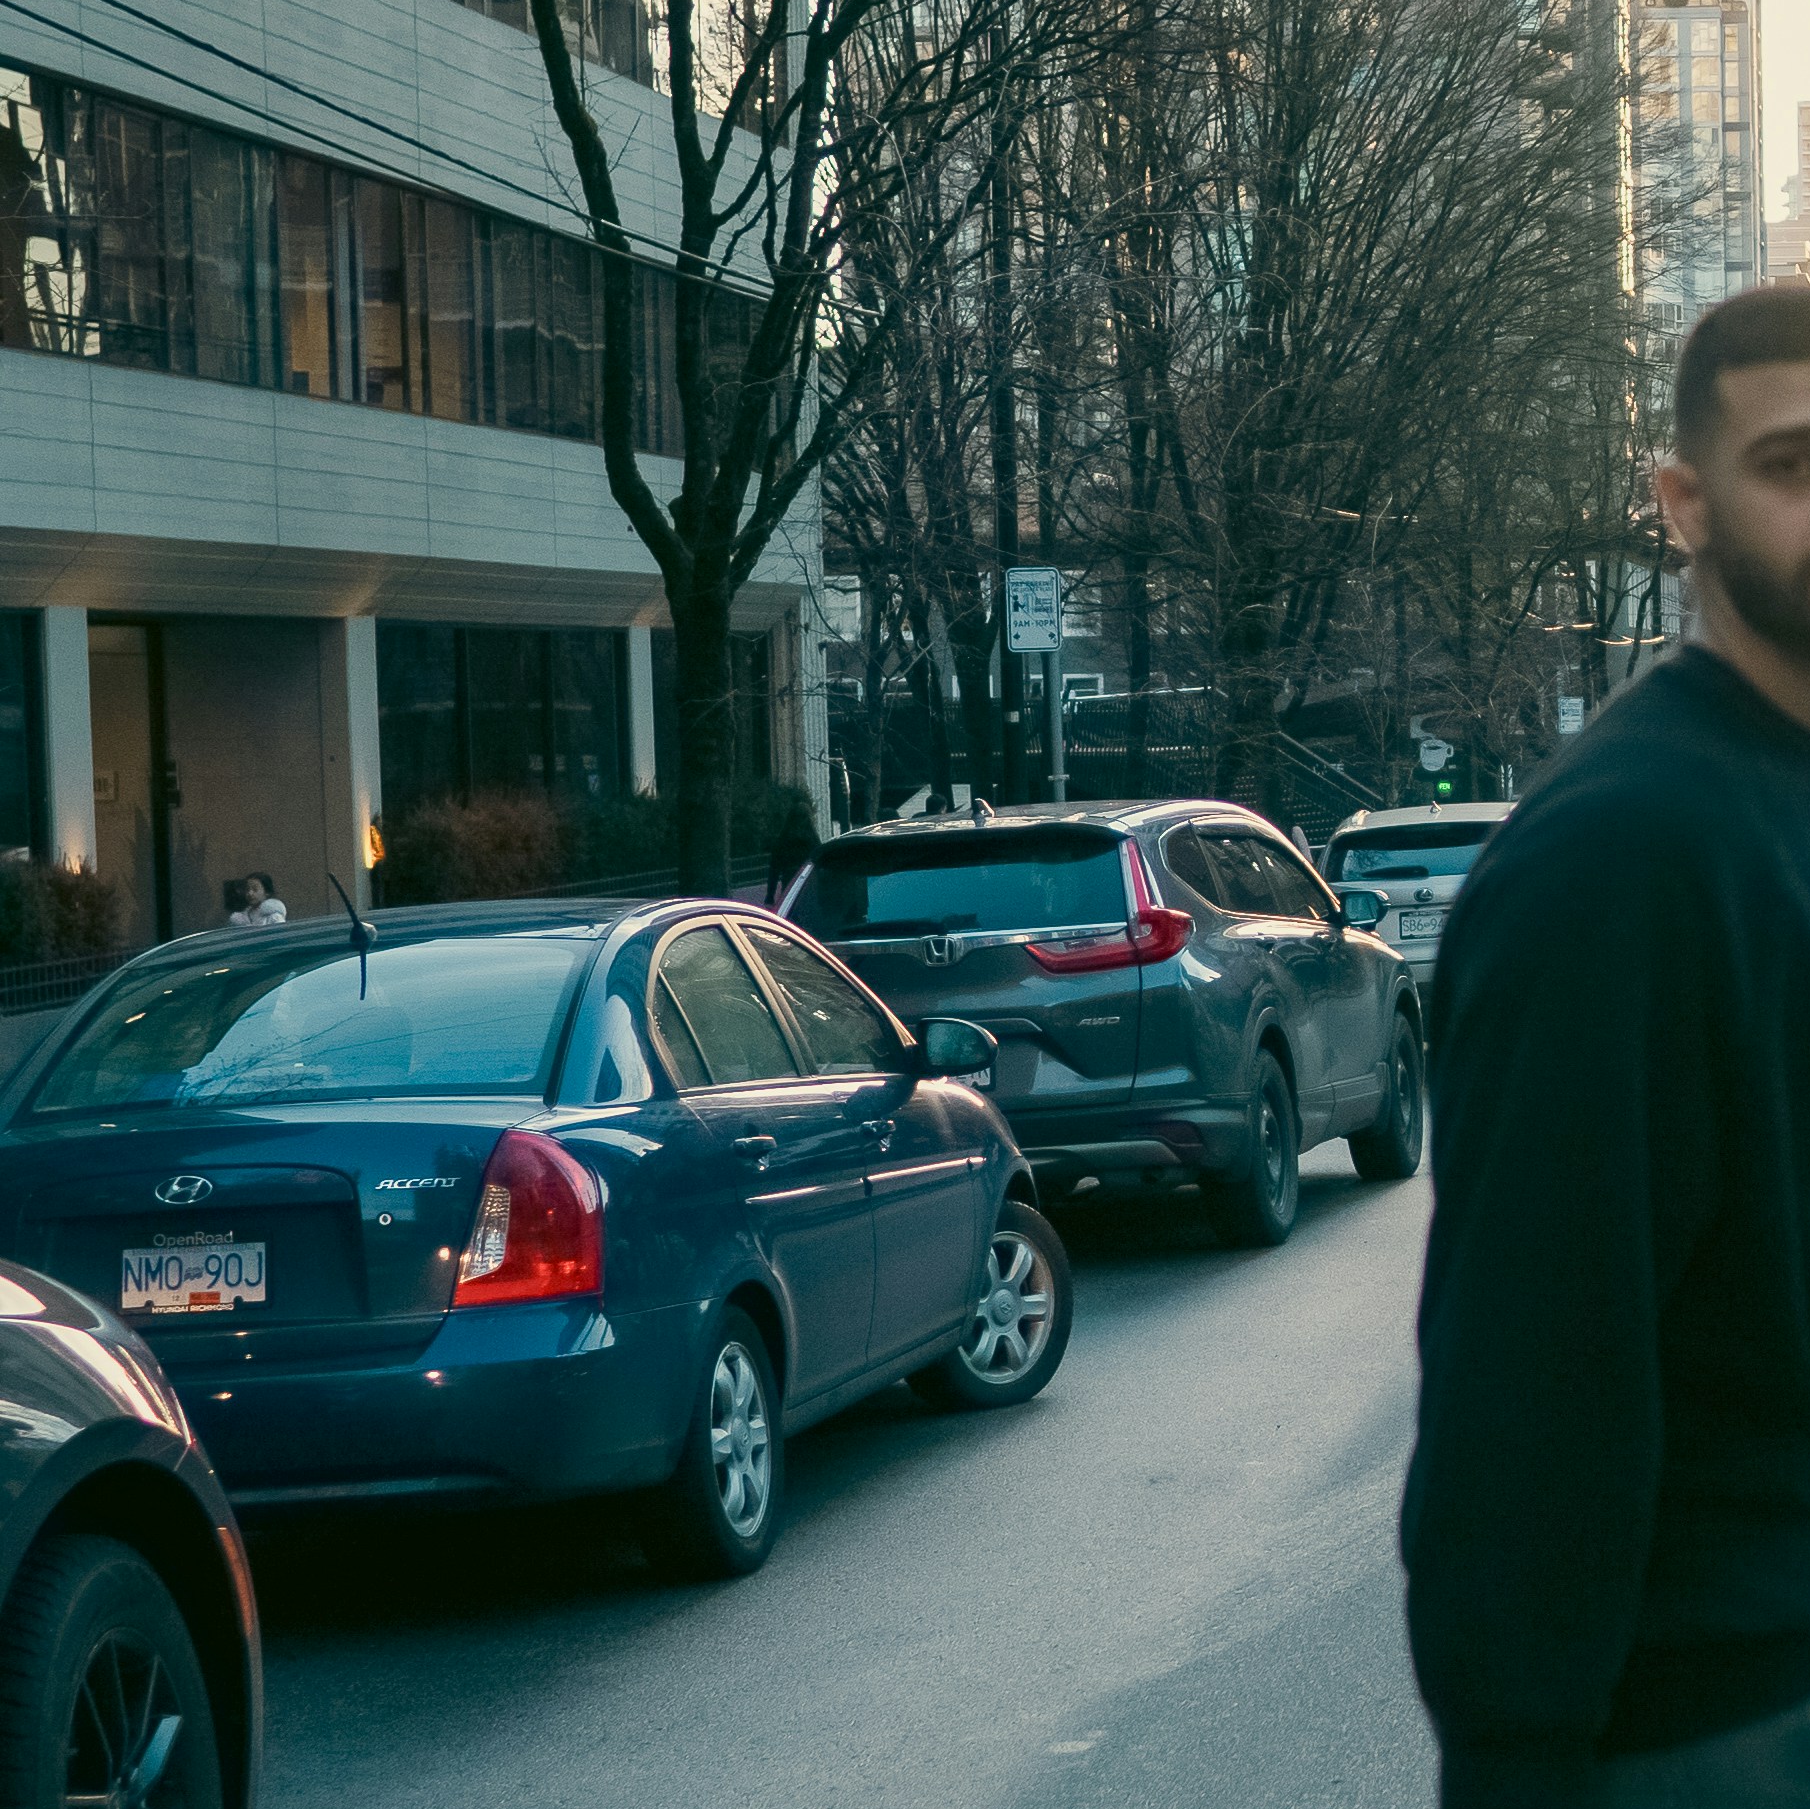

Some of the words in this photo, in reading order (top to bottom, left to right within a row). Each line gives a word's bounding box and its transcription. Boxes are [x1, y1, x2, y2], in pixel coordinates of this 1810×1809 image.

[1076, 1016, 1120, 1027] AWD
[375, 1177, 461, 1190] ACCENT
[153, 1230, 234, 1248] OpenRoad
